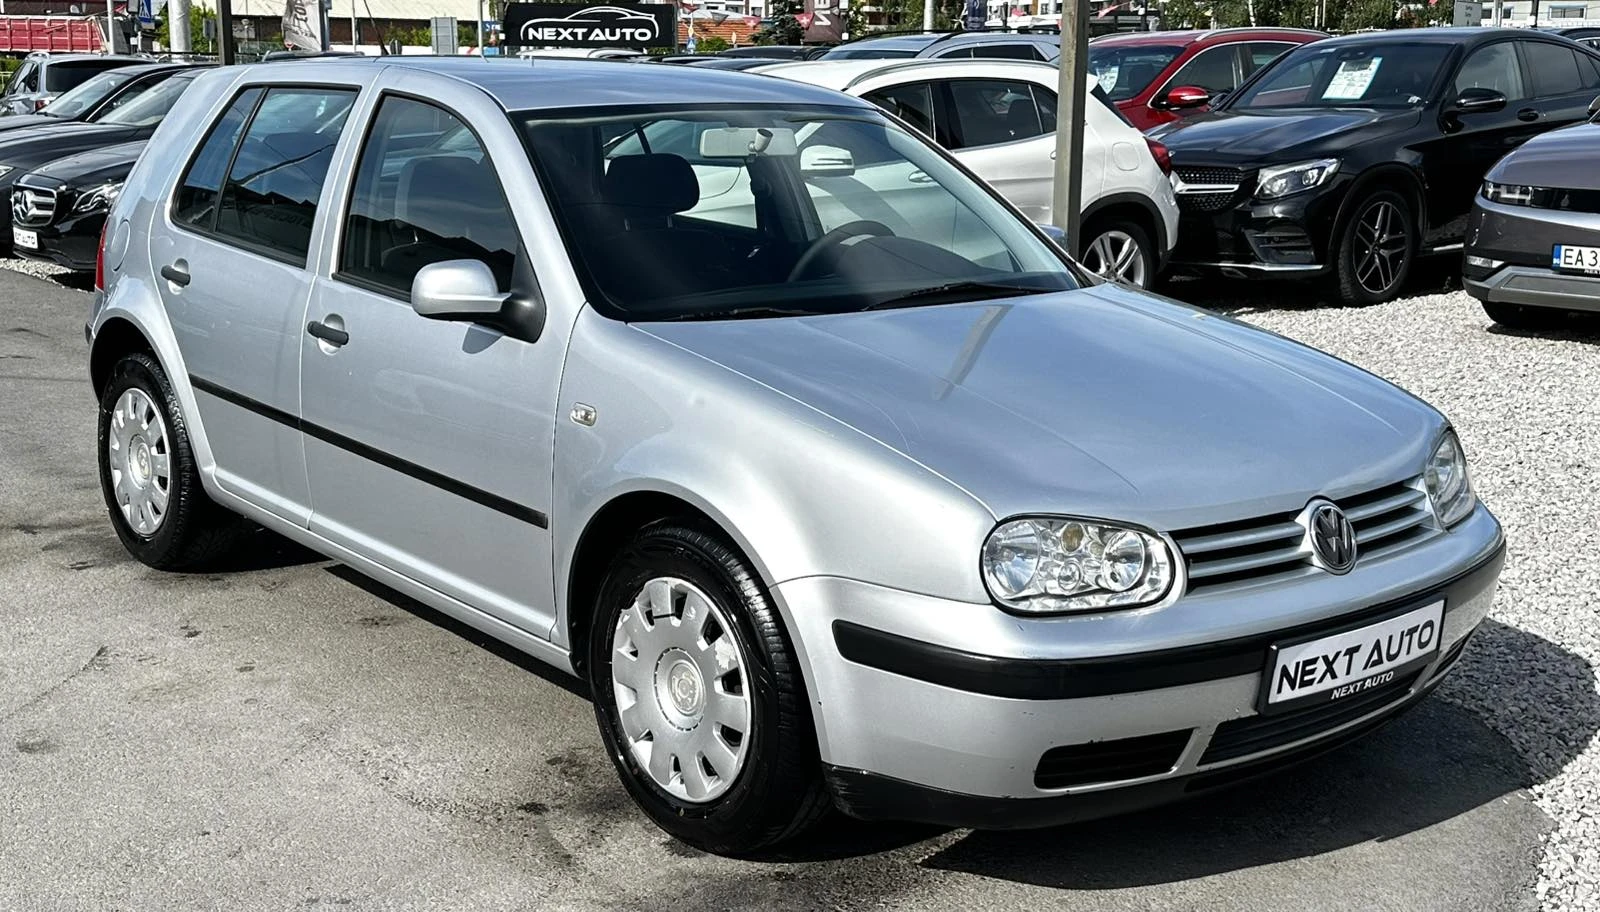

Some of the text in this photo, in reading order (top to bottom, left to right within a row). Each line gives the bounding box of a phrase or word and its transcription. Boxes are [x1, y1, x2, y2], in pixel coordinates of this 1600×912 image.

[528, 28, 652, 41] NEXT AUTO
[1563, 248, 1600, 268] EA 3
[1311, 507, 1355, 567] VW
[1276, 620, 1434, 695] NEXT AUTO
[1331, 672, 1394, 700] NEXT AUTO
